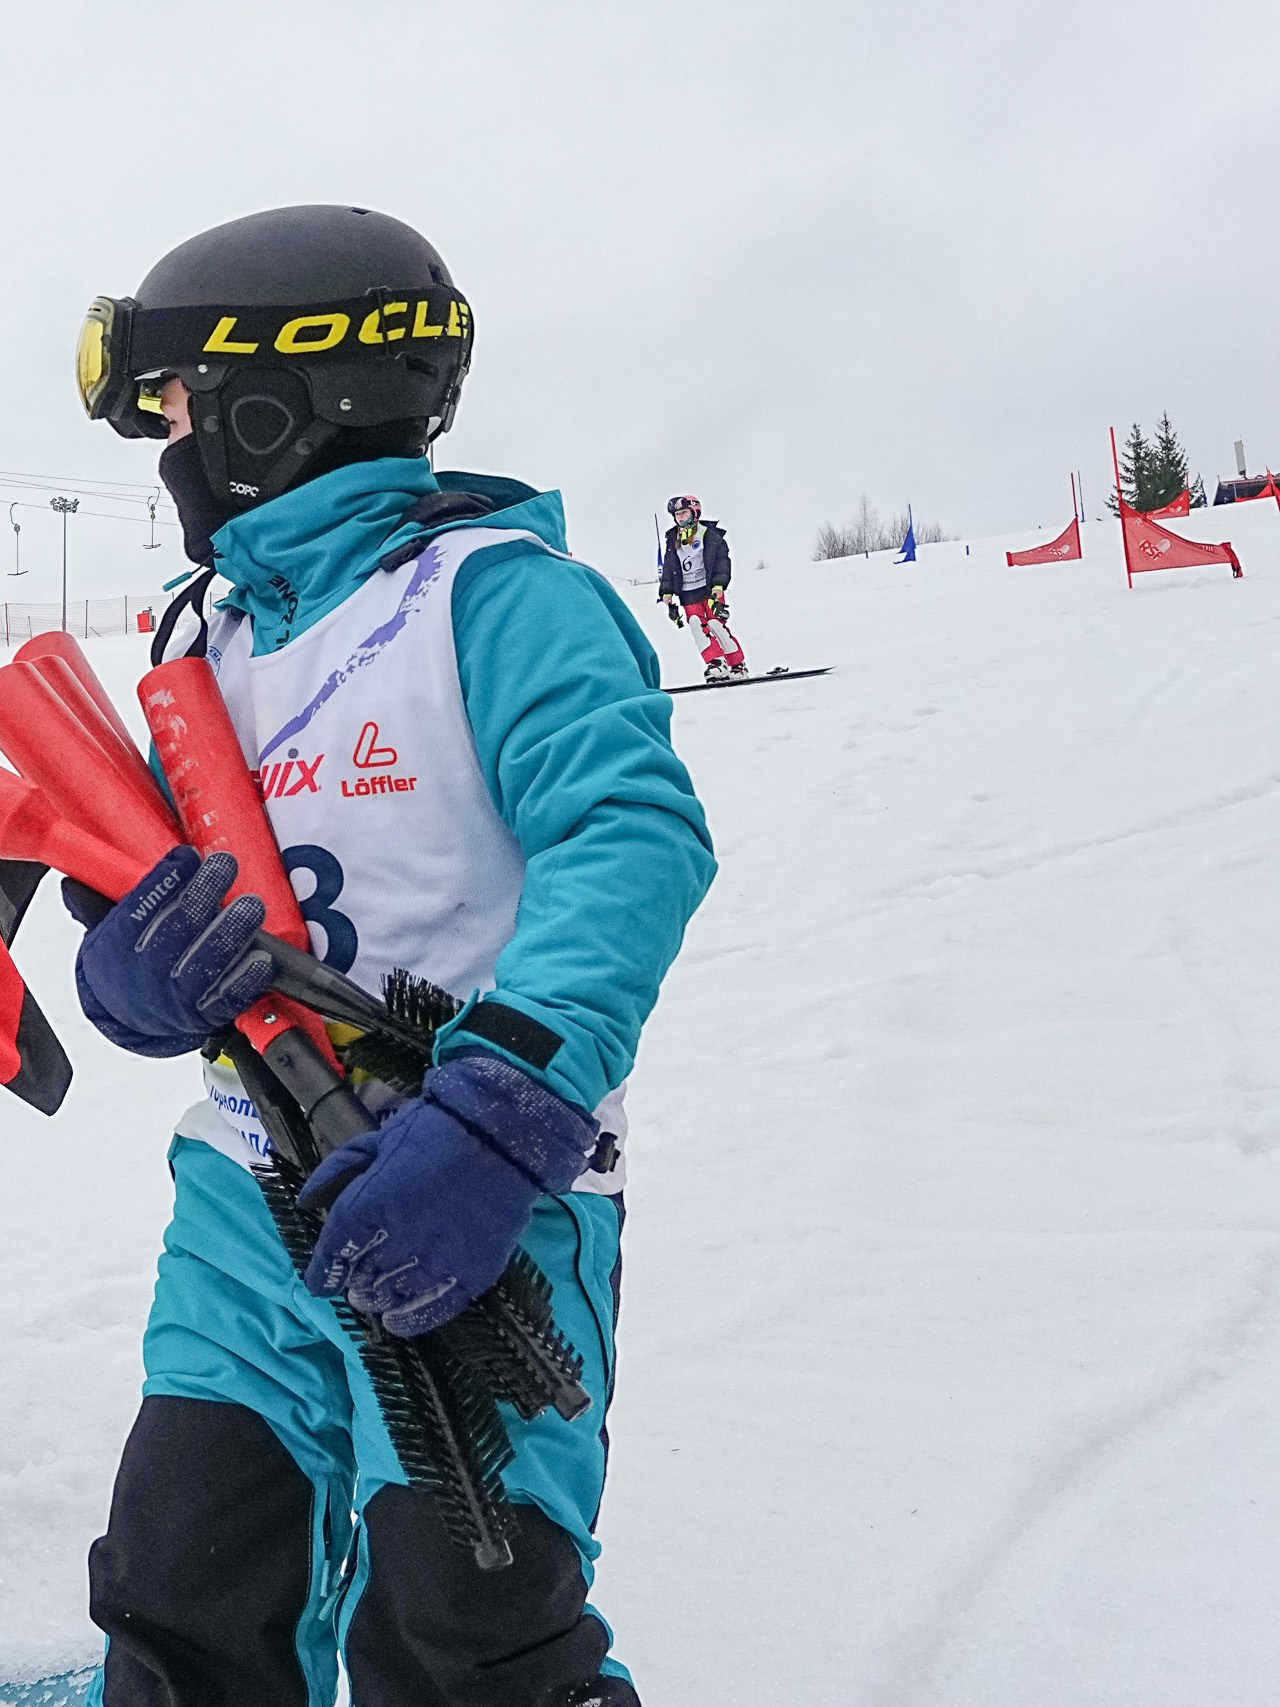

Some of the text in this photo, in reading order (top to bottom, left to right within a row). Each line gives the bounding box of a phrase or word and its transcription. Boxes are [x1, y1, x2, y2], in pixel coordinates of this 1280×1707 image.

[682, 555, 692, 572] 6
[341, 775, 417, 797] Löffler
[130, 868, 180, 921] winter
[323, 1239, 360, 1288] winer
